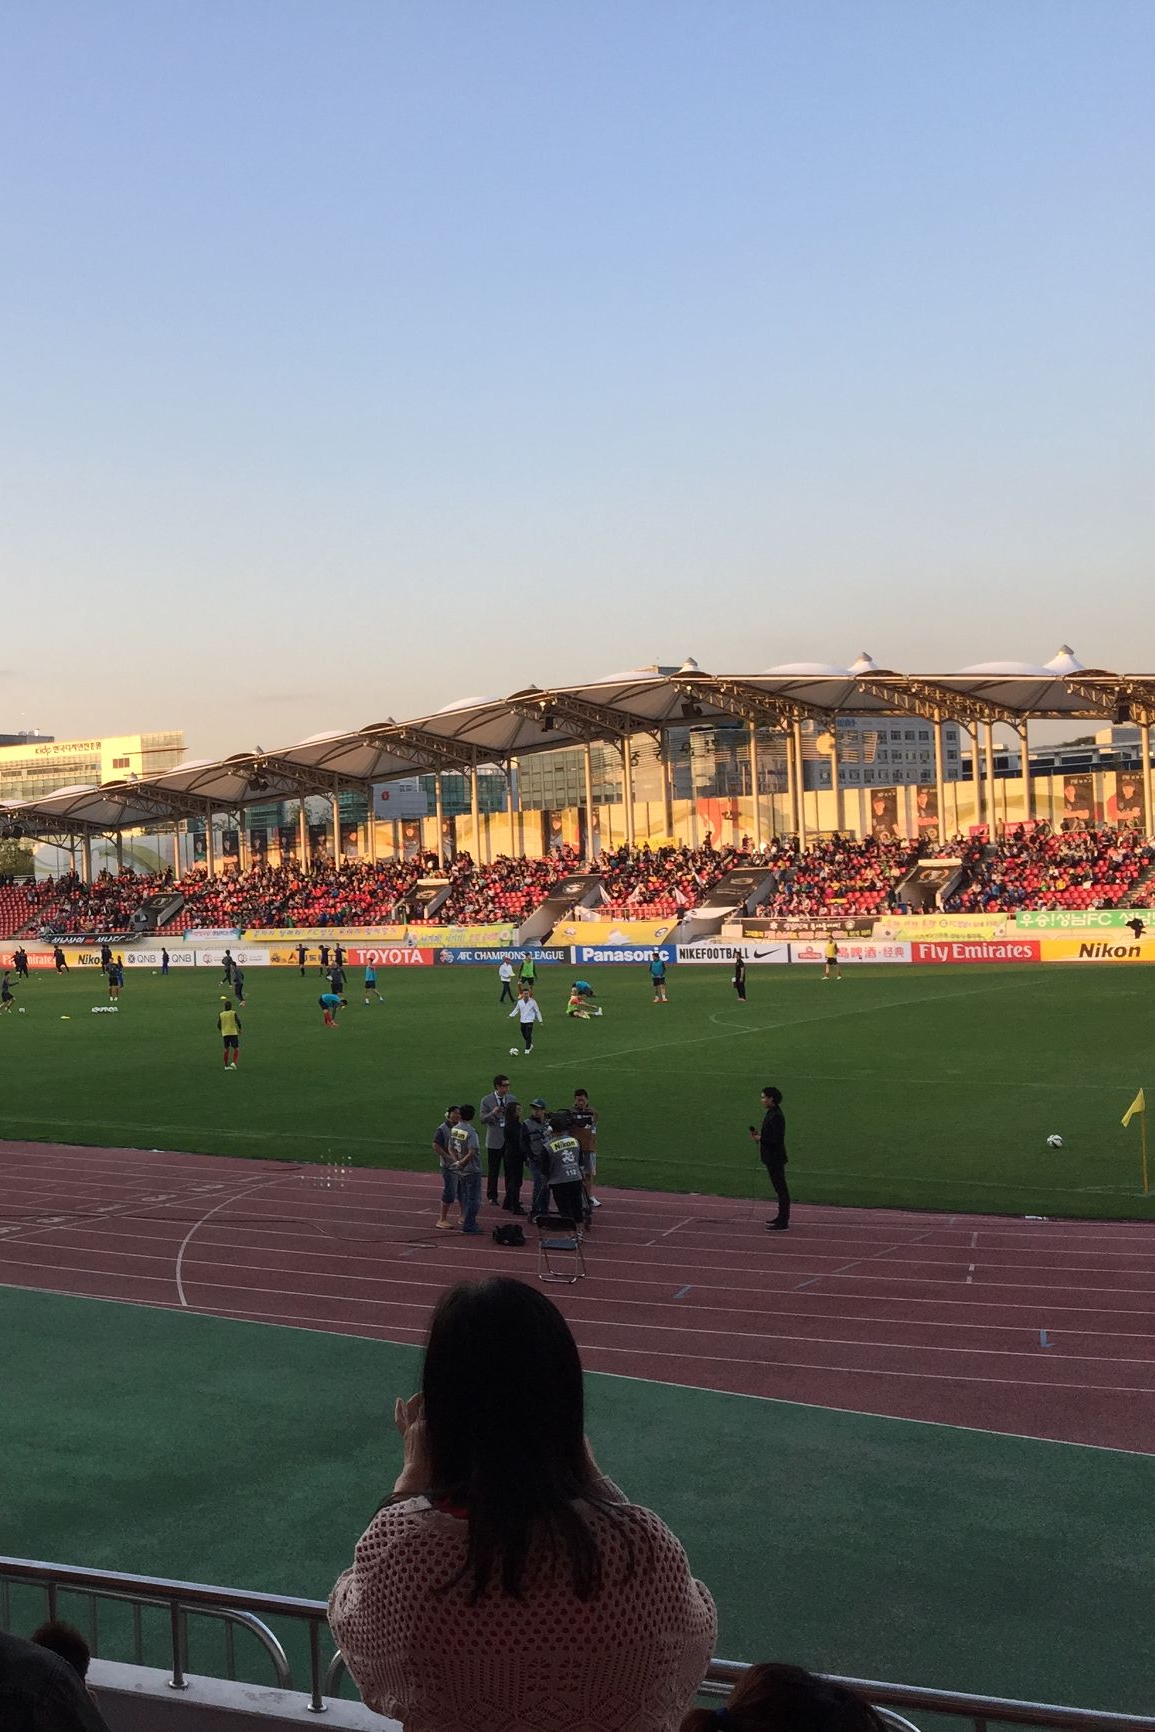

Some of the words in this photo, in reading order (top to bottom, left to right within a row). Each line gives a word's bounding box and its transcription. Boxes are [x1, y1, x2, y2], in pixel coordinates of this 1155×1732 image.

[456, 952, 472, 961] AFC
[474, 951, 527, 961] CHAMPIONS
[918, 943, 949, 962] Fly
[952, 942, 1033, 959] Emirates
[1078, 942, 1142, 958] Nikon
[77, 953, 102, 965] Niko
[137, 954, 156, 963] QNB
[172, 953, 192, 963] QNB
[356, 949, 424, 964] TOYOTA
